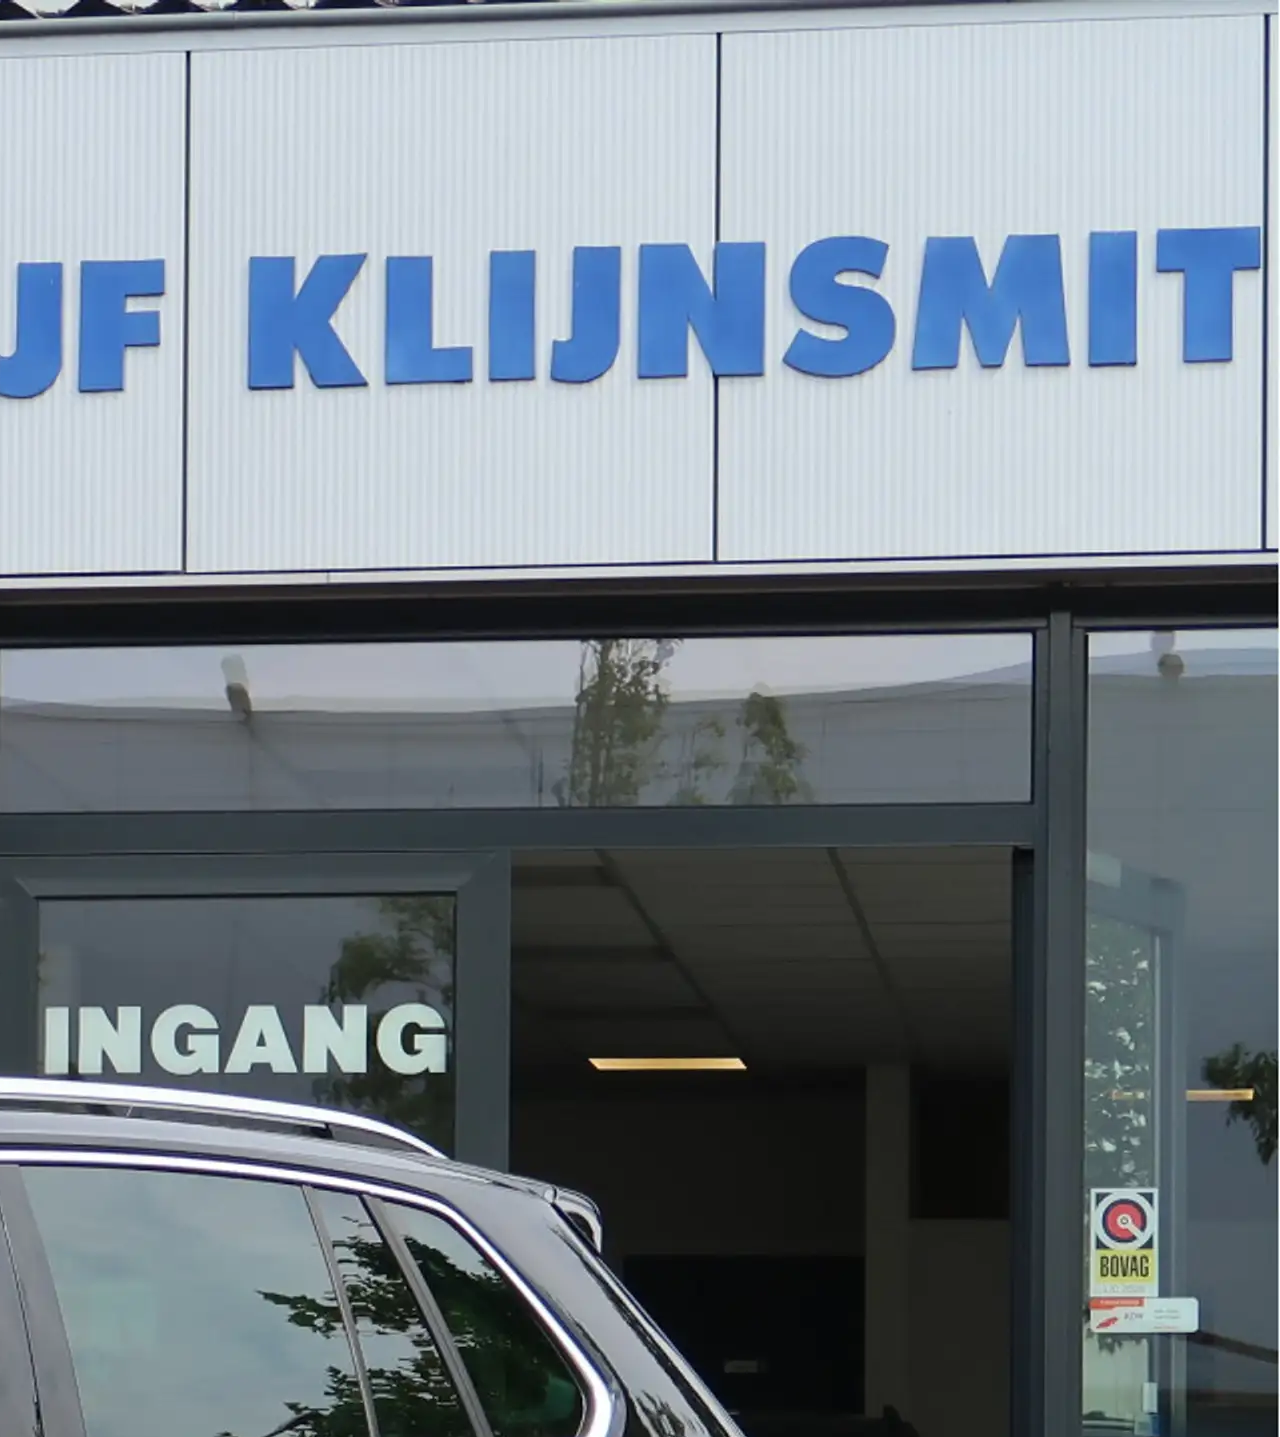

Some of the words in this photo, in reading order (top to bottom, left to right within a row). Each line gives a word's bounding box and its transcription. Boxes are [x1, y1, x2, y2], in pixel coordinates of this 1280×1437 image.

[249, 226, 1260, 390] KLIJNSMIT
[43, 1003, 448, 1076] INGANG
[1099, 1253, 1150, 1278] BOVAG
